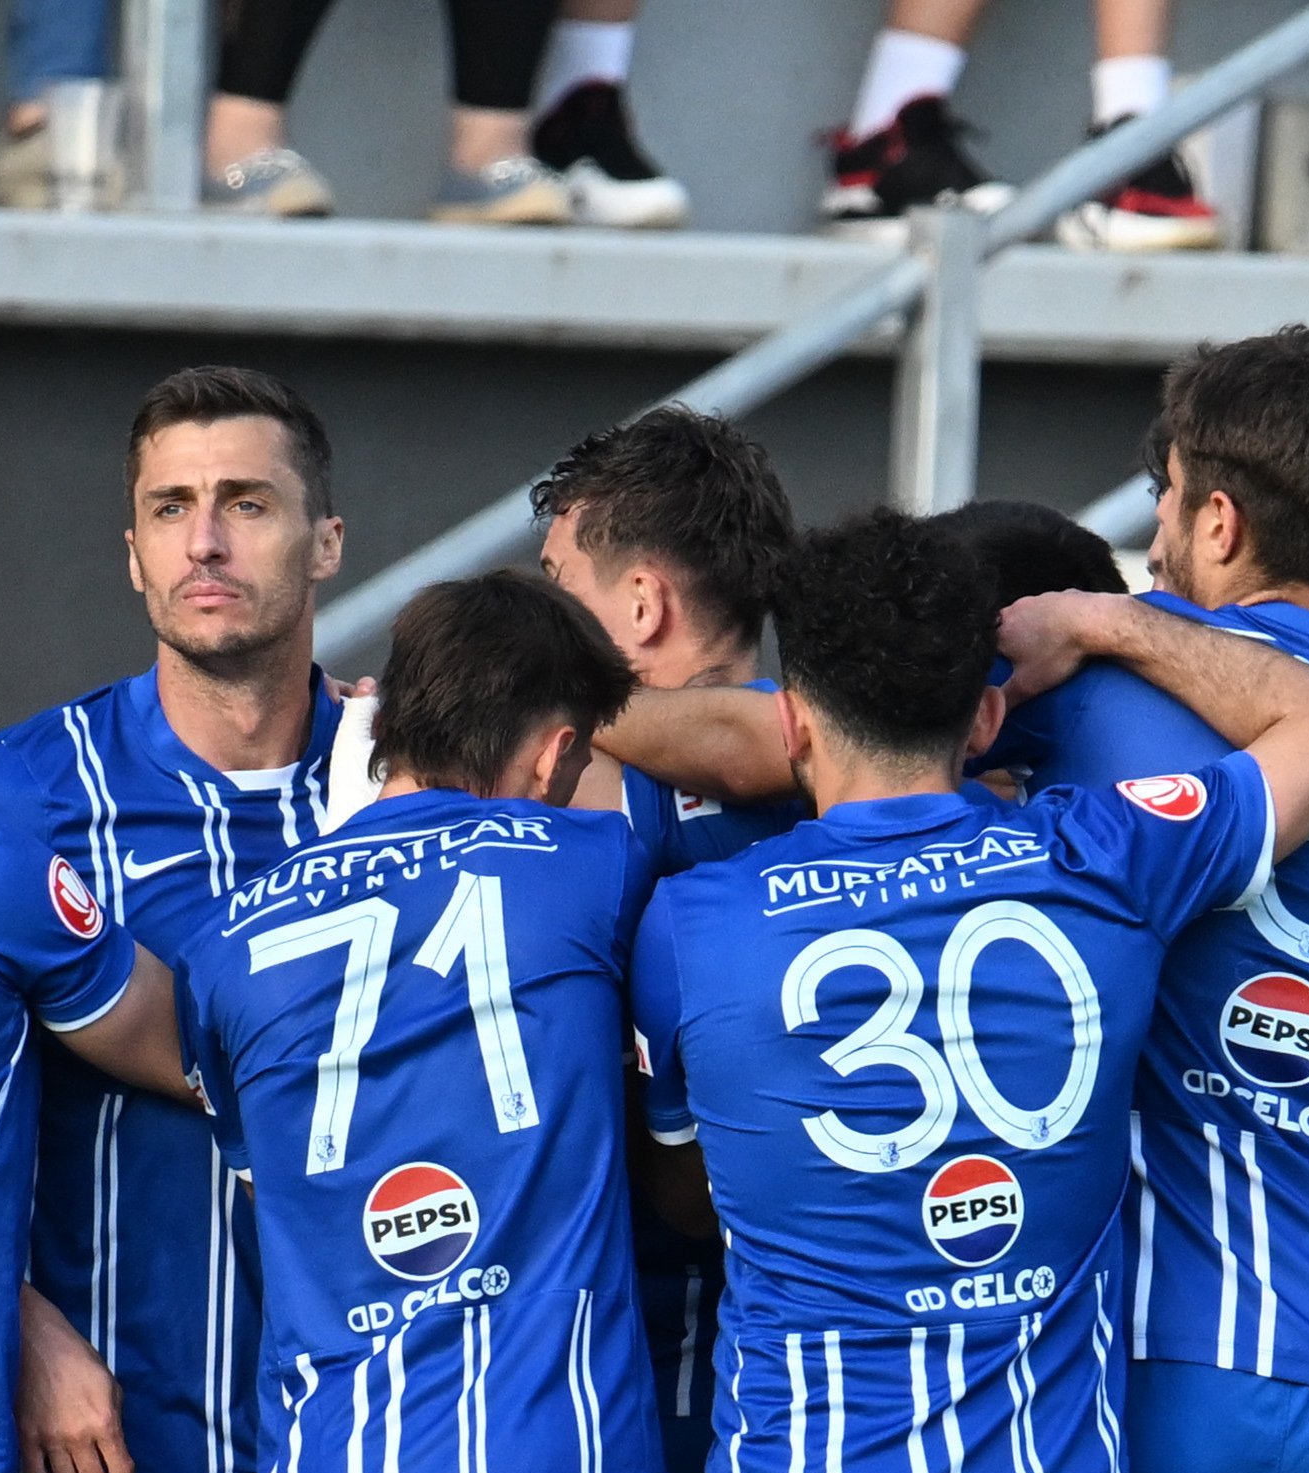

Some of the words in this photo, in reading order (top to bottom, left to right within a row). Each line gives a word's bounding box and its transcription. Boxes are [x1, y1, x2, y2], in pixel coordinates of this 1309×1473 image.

[228, 817, 552, 921] MURFATLAR
[306, 858, 458, 908] VINUL
[768, 836, 1043, 903] MURFATLAR
[849, 872, 975, 907] VINUL
[248, 870, 540, 1176] 71
[781, 900, 1103, 1174] 30
[371, 1200, 471, 1243] PEPSI
[929, 1193, 1017, 1228] PEPSI
[951, 1265, 1056, 1310] CELCO
